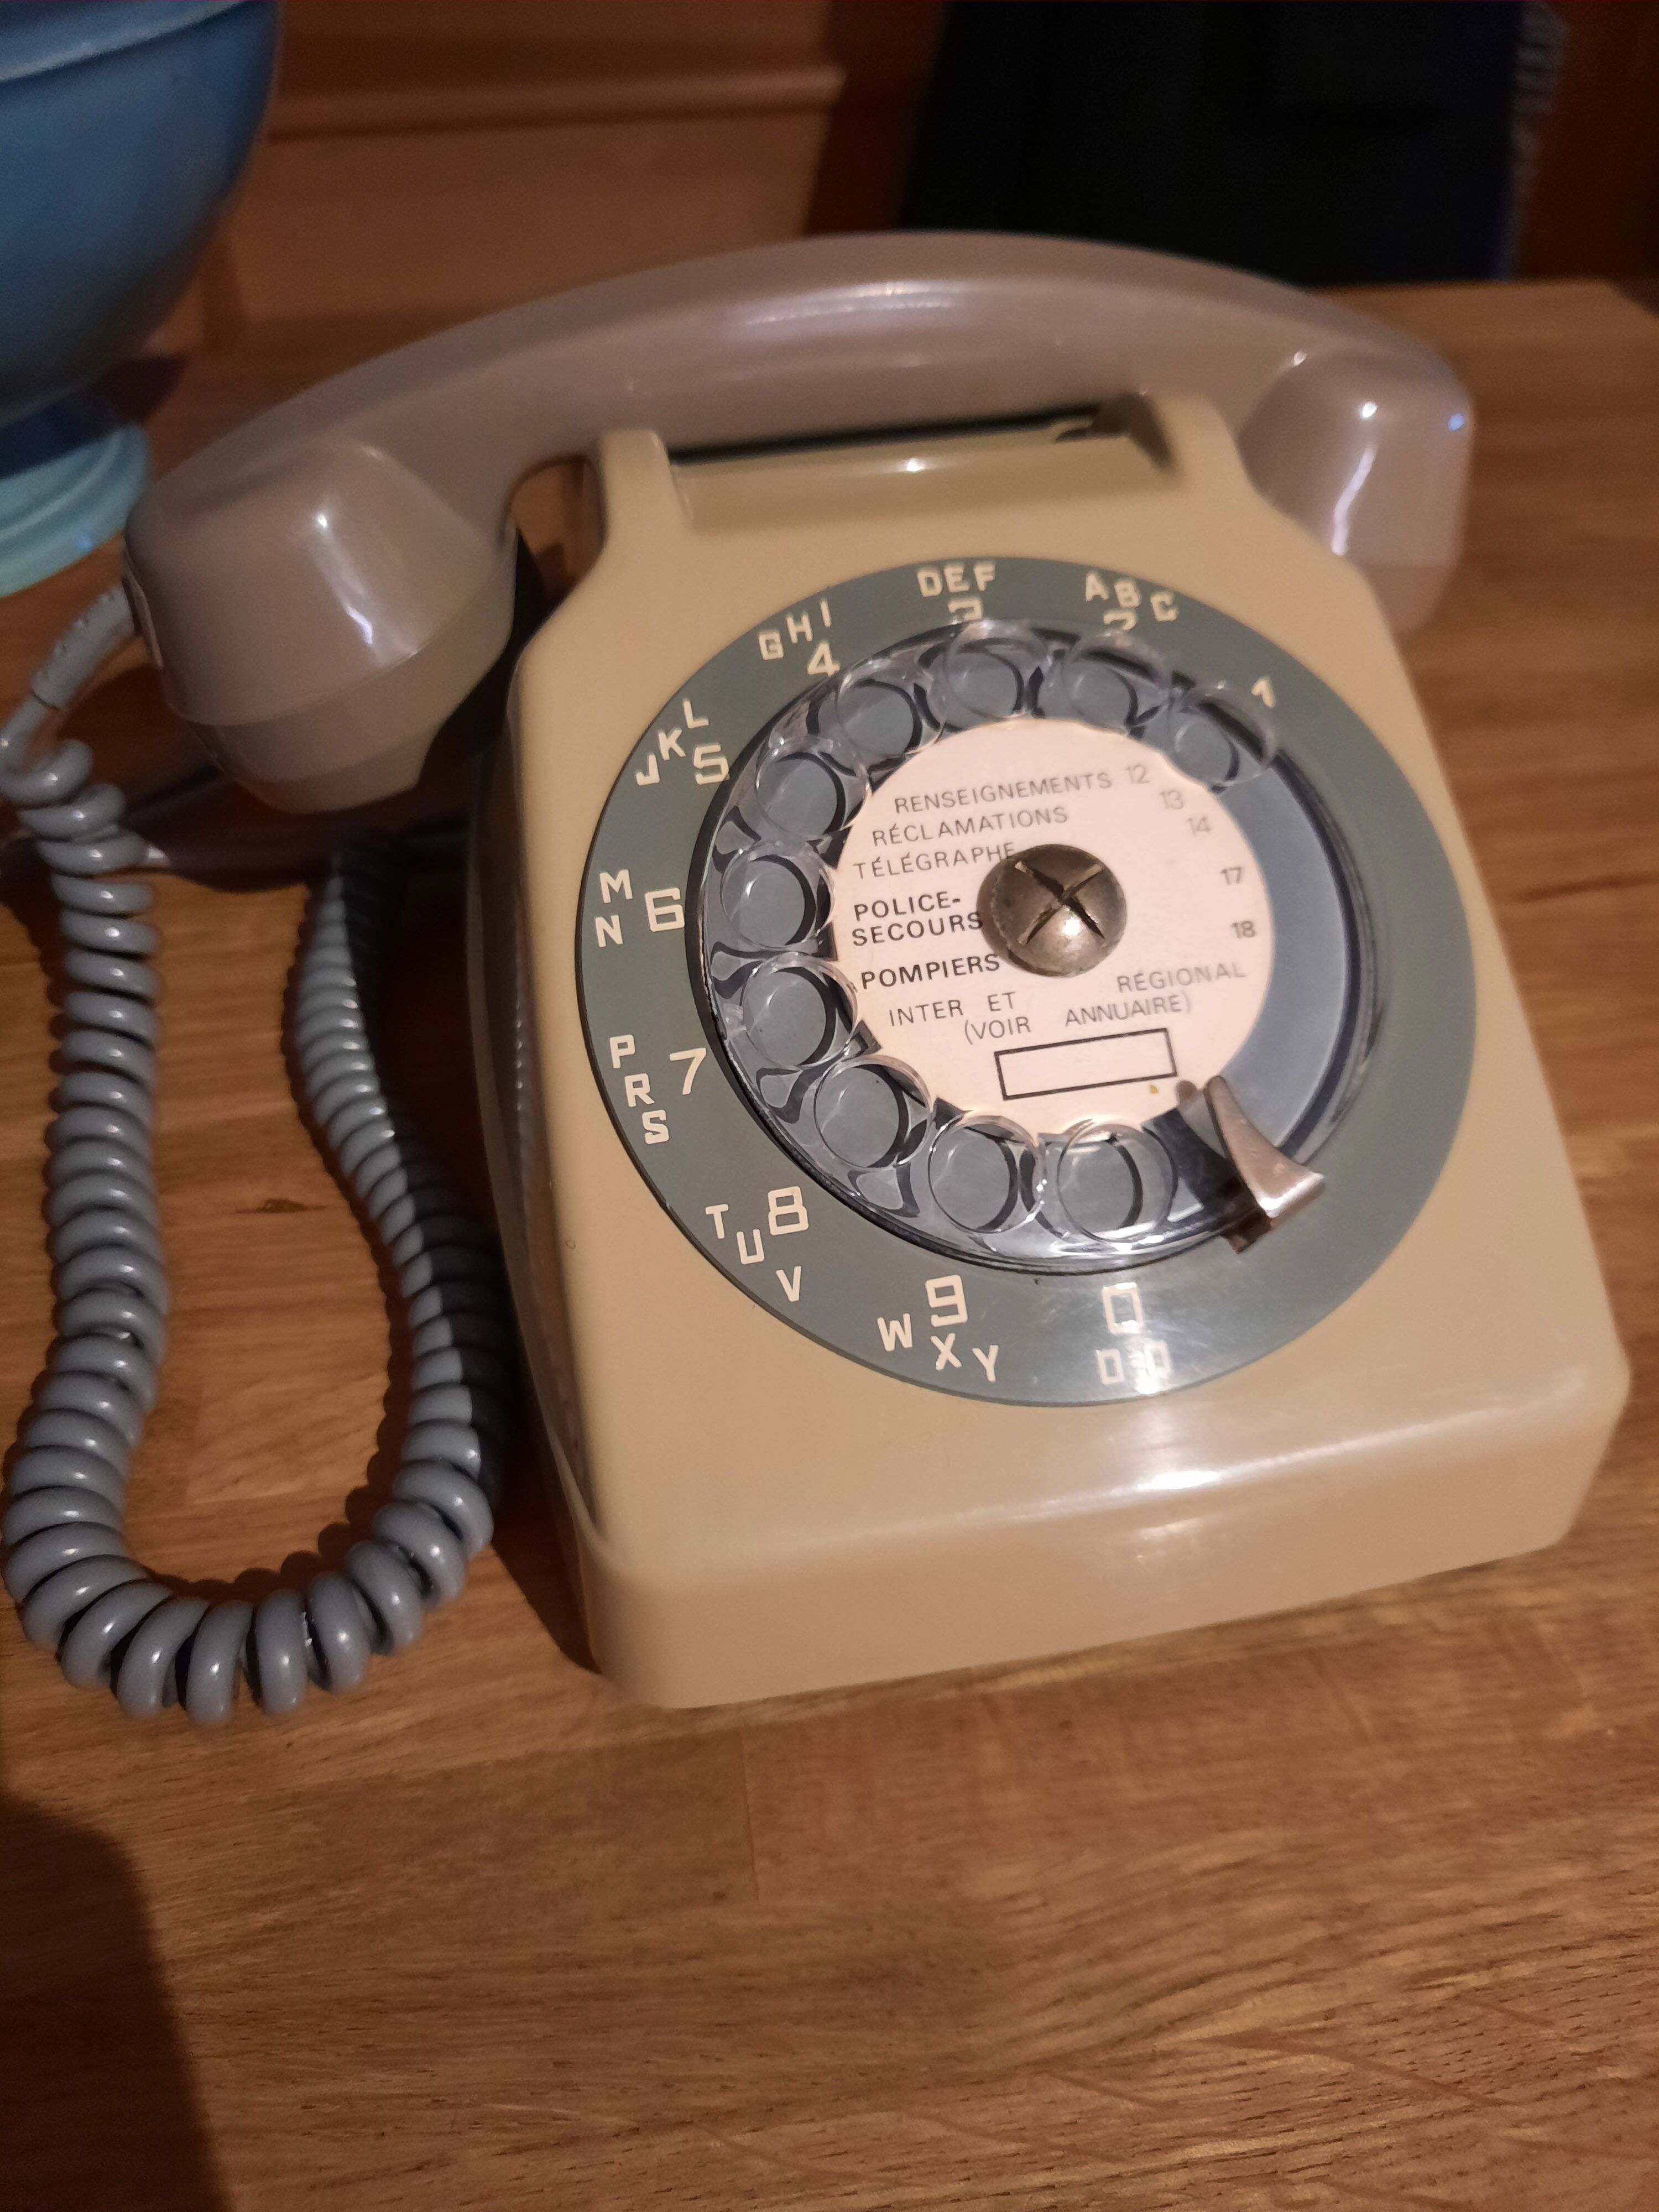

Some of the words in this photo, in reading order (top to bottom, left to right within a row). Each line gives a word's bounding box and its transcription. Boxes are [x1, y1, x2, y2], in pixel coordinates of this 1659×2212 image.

[916, 562, 995, 598] DEF
[1085, 571, 1179, 622] ABC
[758, 597, 832, 660] GHI
[807, 640, 841, 677] 4
[636, 699, 709, 786] JKL
[693, 744, 731, 785] 5
[894, 771, 1113, 814] RENSEIGNEMENTS
[1125, 764, 1151, 784] 12
[872, 805, 1068, 847] RÉCLAMATIONS
[1161, 789, 1185, 810] 13
[853, 842, 1015, 880] TÉLÉGRAPHE
[1186, 816, 1212, 836] 14
[644, 888, 686, 932] 6
[852, 912, 983, 947] SECOURS
[1220, 866, 1243, 885] 17
[853, 891, 961, 922] POLICE-
[860, 953, 1000, 990] POMPIERS
[1231, 920, 1257, 939] 18
[888, 999, 964, 1027] INTER
[987, 992, 1016, 1012] ET
[1117, 961, 1246, 994] RÉGIONAL
[964, 1015, 1032, 1045] (VOIR
[1065, 990, 1191, 1027] ANNUAIRE)
[609, 1034, 670, 1145] PRS
[669, 1047, 707, 1095] 7
[767, 1186, 810, 1236] 8
[705, 1203, 802, 1302] TUV
[925, 1274, 968, 1328] 9
[877, 1313, 999, 1383] WXY
